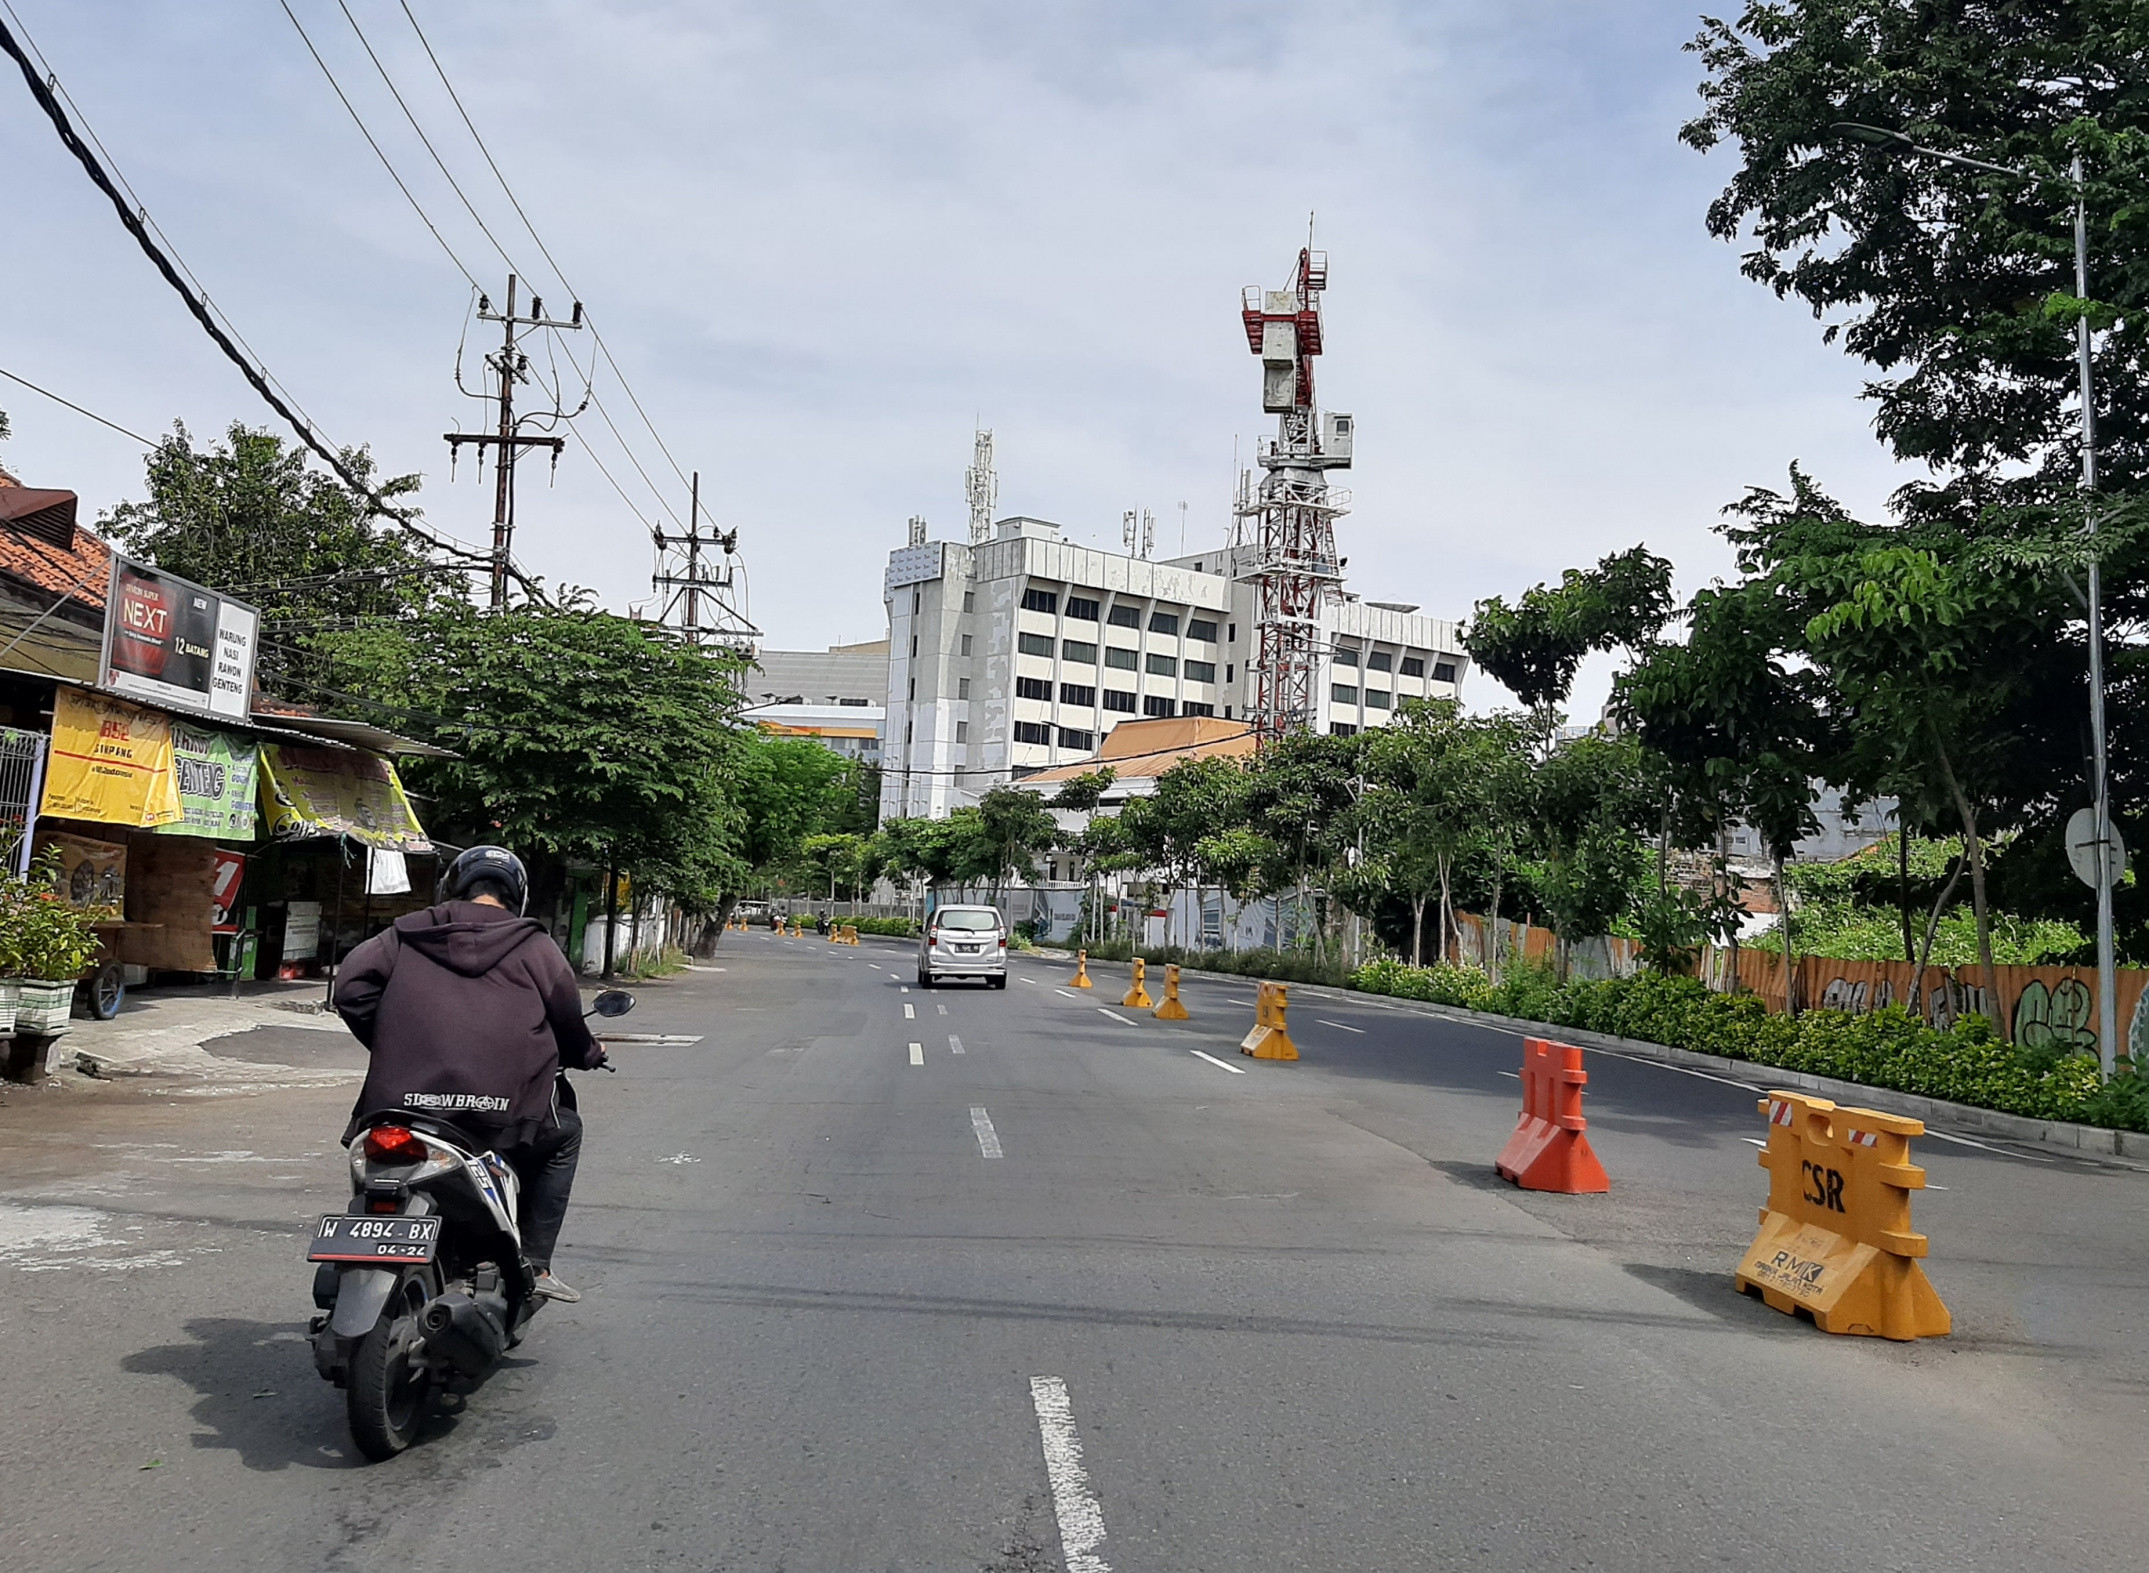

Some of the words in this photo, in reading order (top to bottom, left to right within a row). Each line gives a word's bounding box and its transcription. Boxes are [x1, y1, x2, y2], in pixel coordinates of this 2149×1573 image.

[124, 598, 167, 633] NEXT
[175, 636, 185, 656] 12
[186, 645, 209, 658] BATANG
[218, 629, 246, 647] WARUNG
[223, 647, 239, 661] NASI
[218, 662, 242, 678] RAWON
[212, 677, 242, 694] GENTENG
[466, 1159, 493, 1190] 125
[1802, 1160, 1846, 1213] CSR
[324, 1222, 338, 1238] W
[349, 1221, 395, 1238] 4894
[408, 1224, 434, 1240] BX
[1771, 1250, 1825, 1283] RMK
